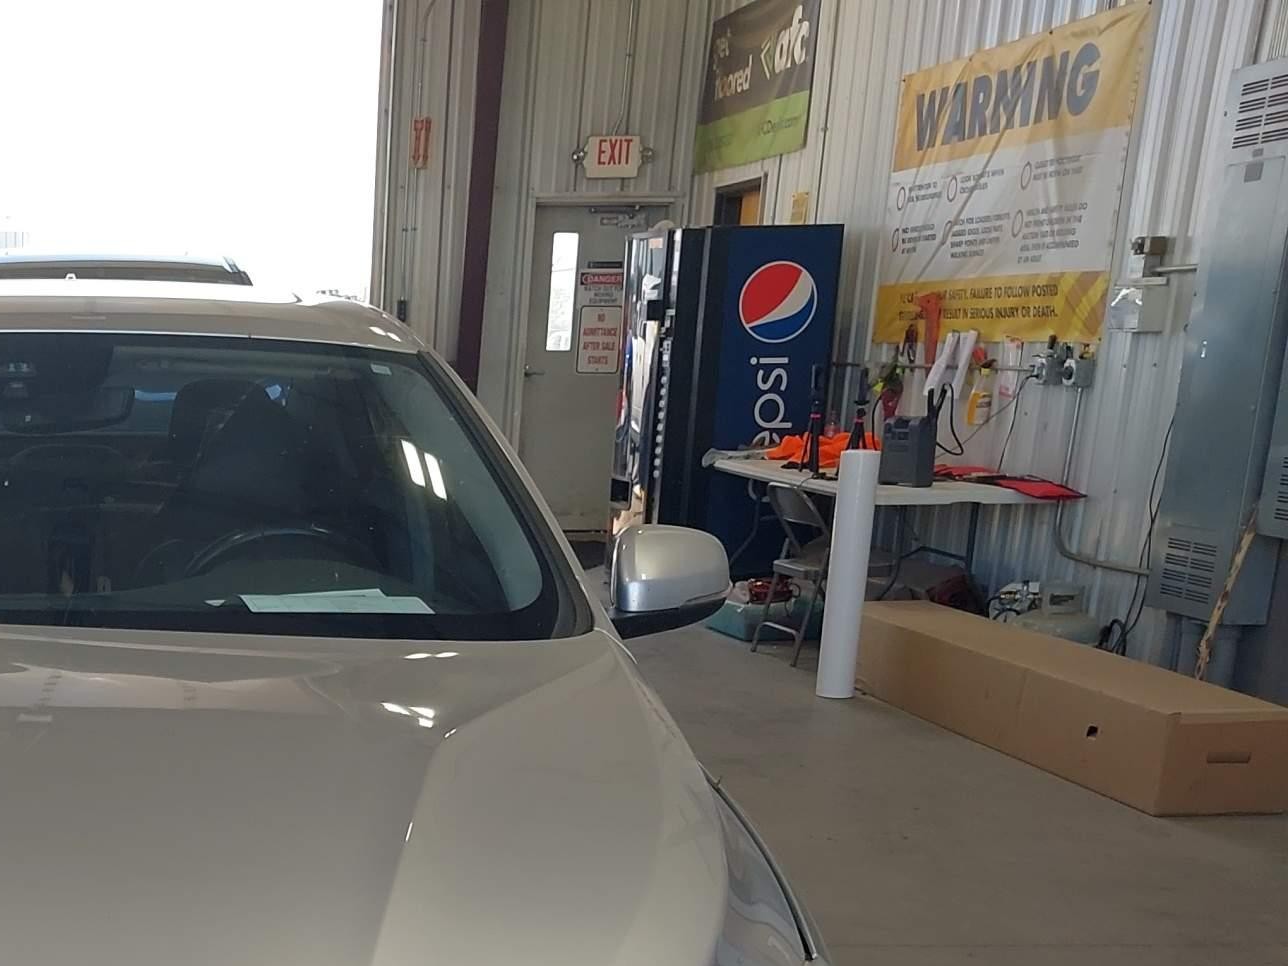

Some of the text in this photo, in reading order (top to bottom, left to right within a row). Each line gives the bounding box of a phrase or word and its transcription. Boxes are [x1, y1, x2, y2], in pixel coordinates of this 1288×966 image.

[774, 5, 810, 74] afc
[915, 42, 1101, 152] WARNING
[596, 138, 633, 166] EXIT
[969, 287, 992, 299] FAILURE
[994, 286, 1003, 298] TO
[1003, 285, 1030, 298] FOLLOW
[1032, 284, 1058, 297] POSTED
[969, 307, 994, 319] SERIOUS
[995, 306, 1019, 319] INJURY
